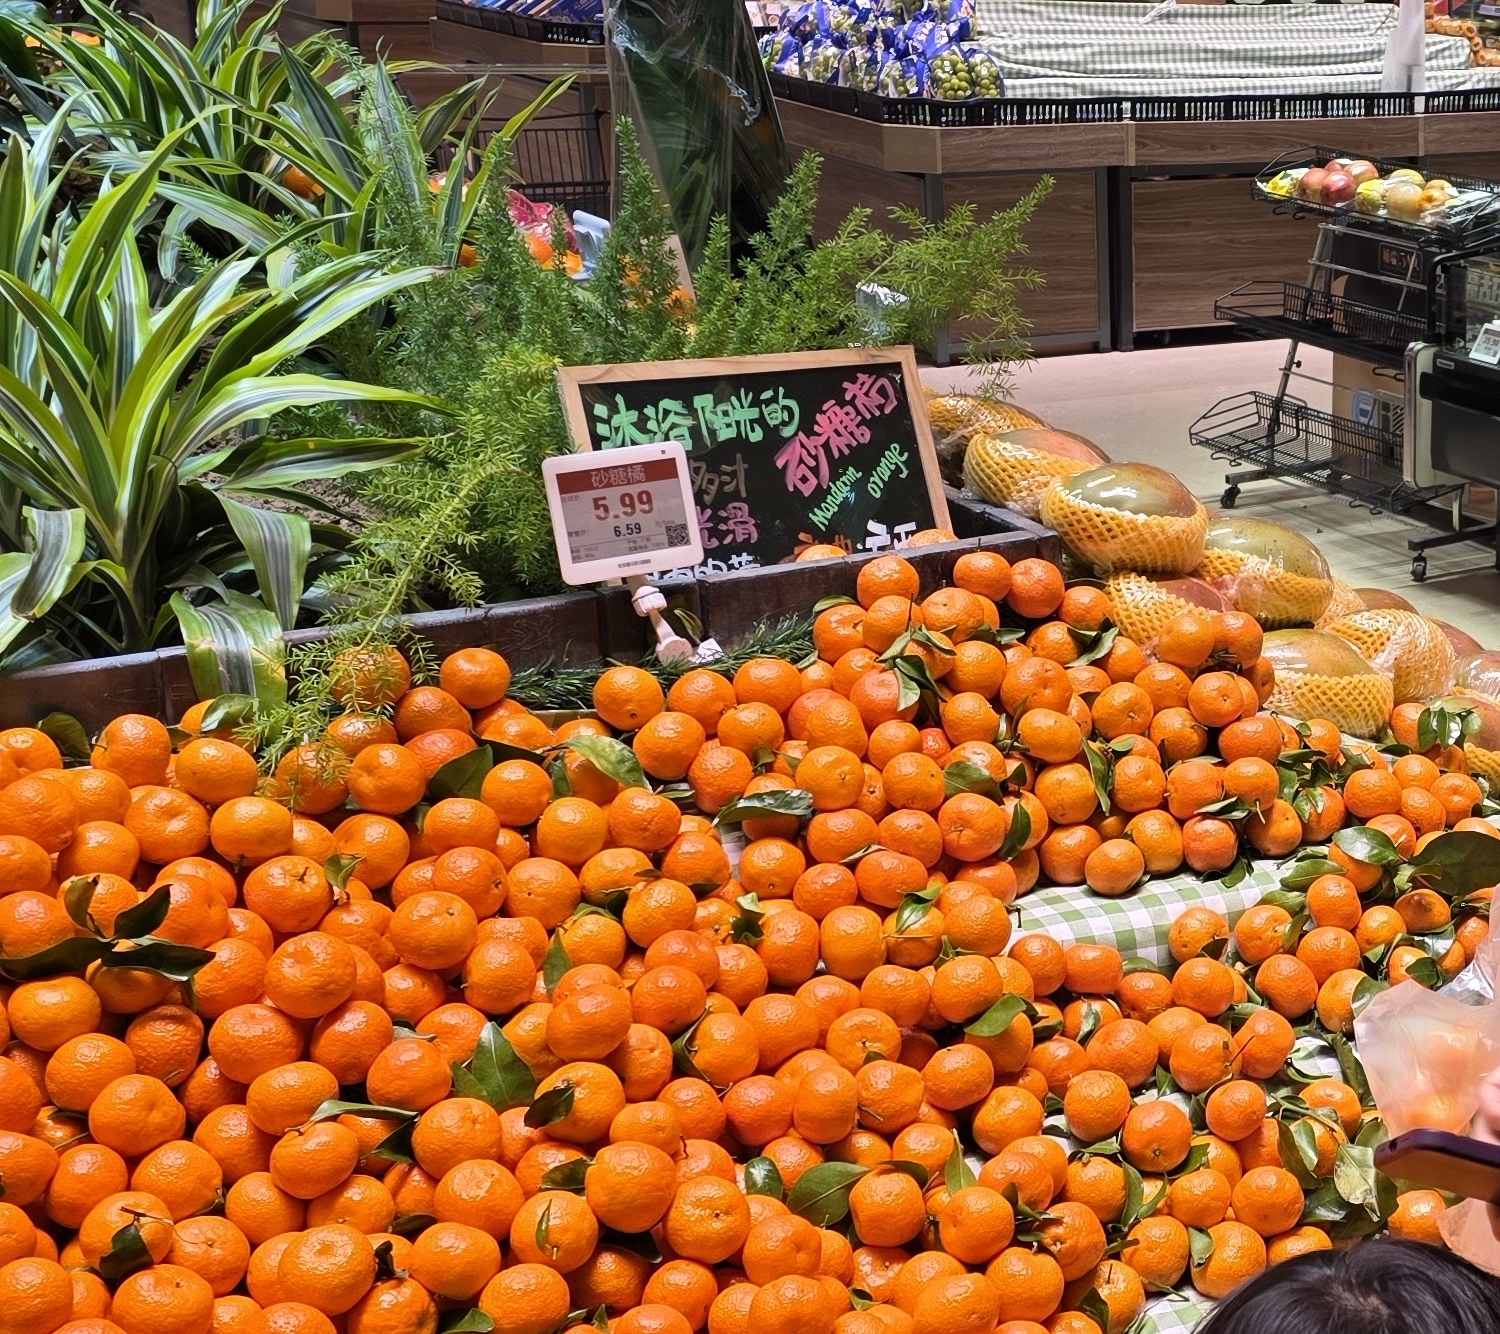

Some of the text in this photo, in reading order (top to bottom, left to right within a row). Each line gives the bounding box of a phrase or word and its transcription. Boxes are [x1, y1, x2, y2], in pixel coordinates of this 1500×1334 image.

[593, 387, 800, 451] 沐浴阳光的
[591, 465, 645, 489] 砂糖橘
[867, 442, 908, 498] orange
[592, 490, 654, 522] 5.99
[808, 465, 862, 531] Mandarin
[613, 522, 642, 538] 6.59
